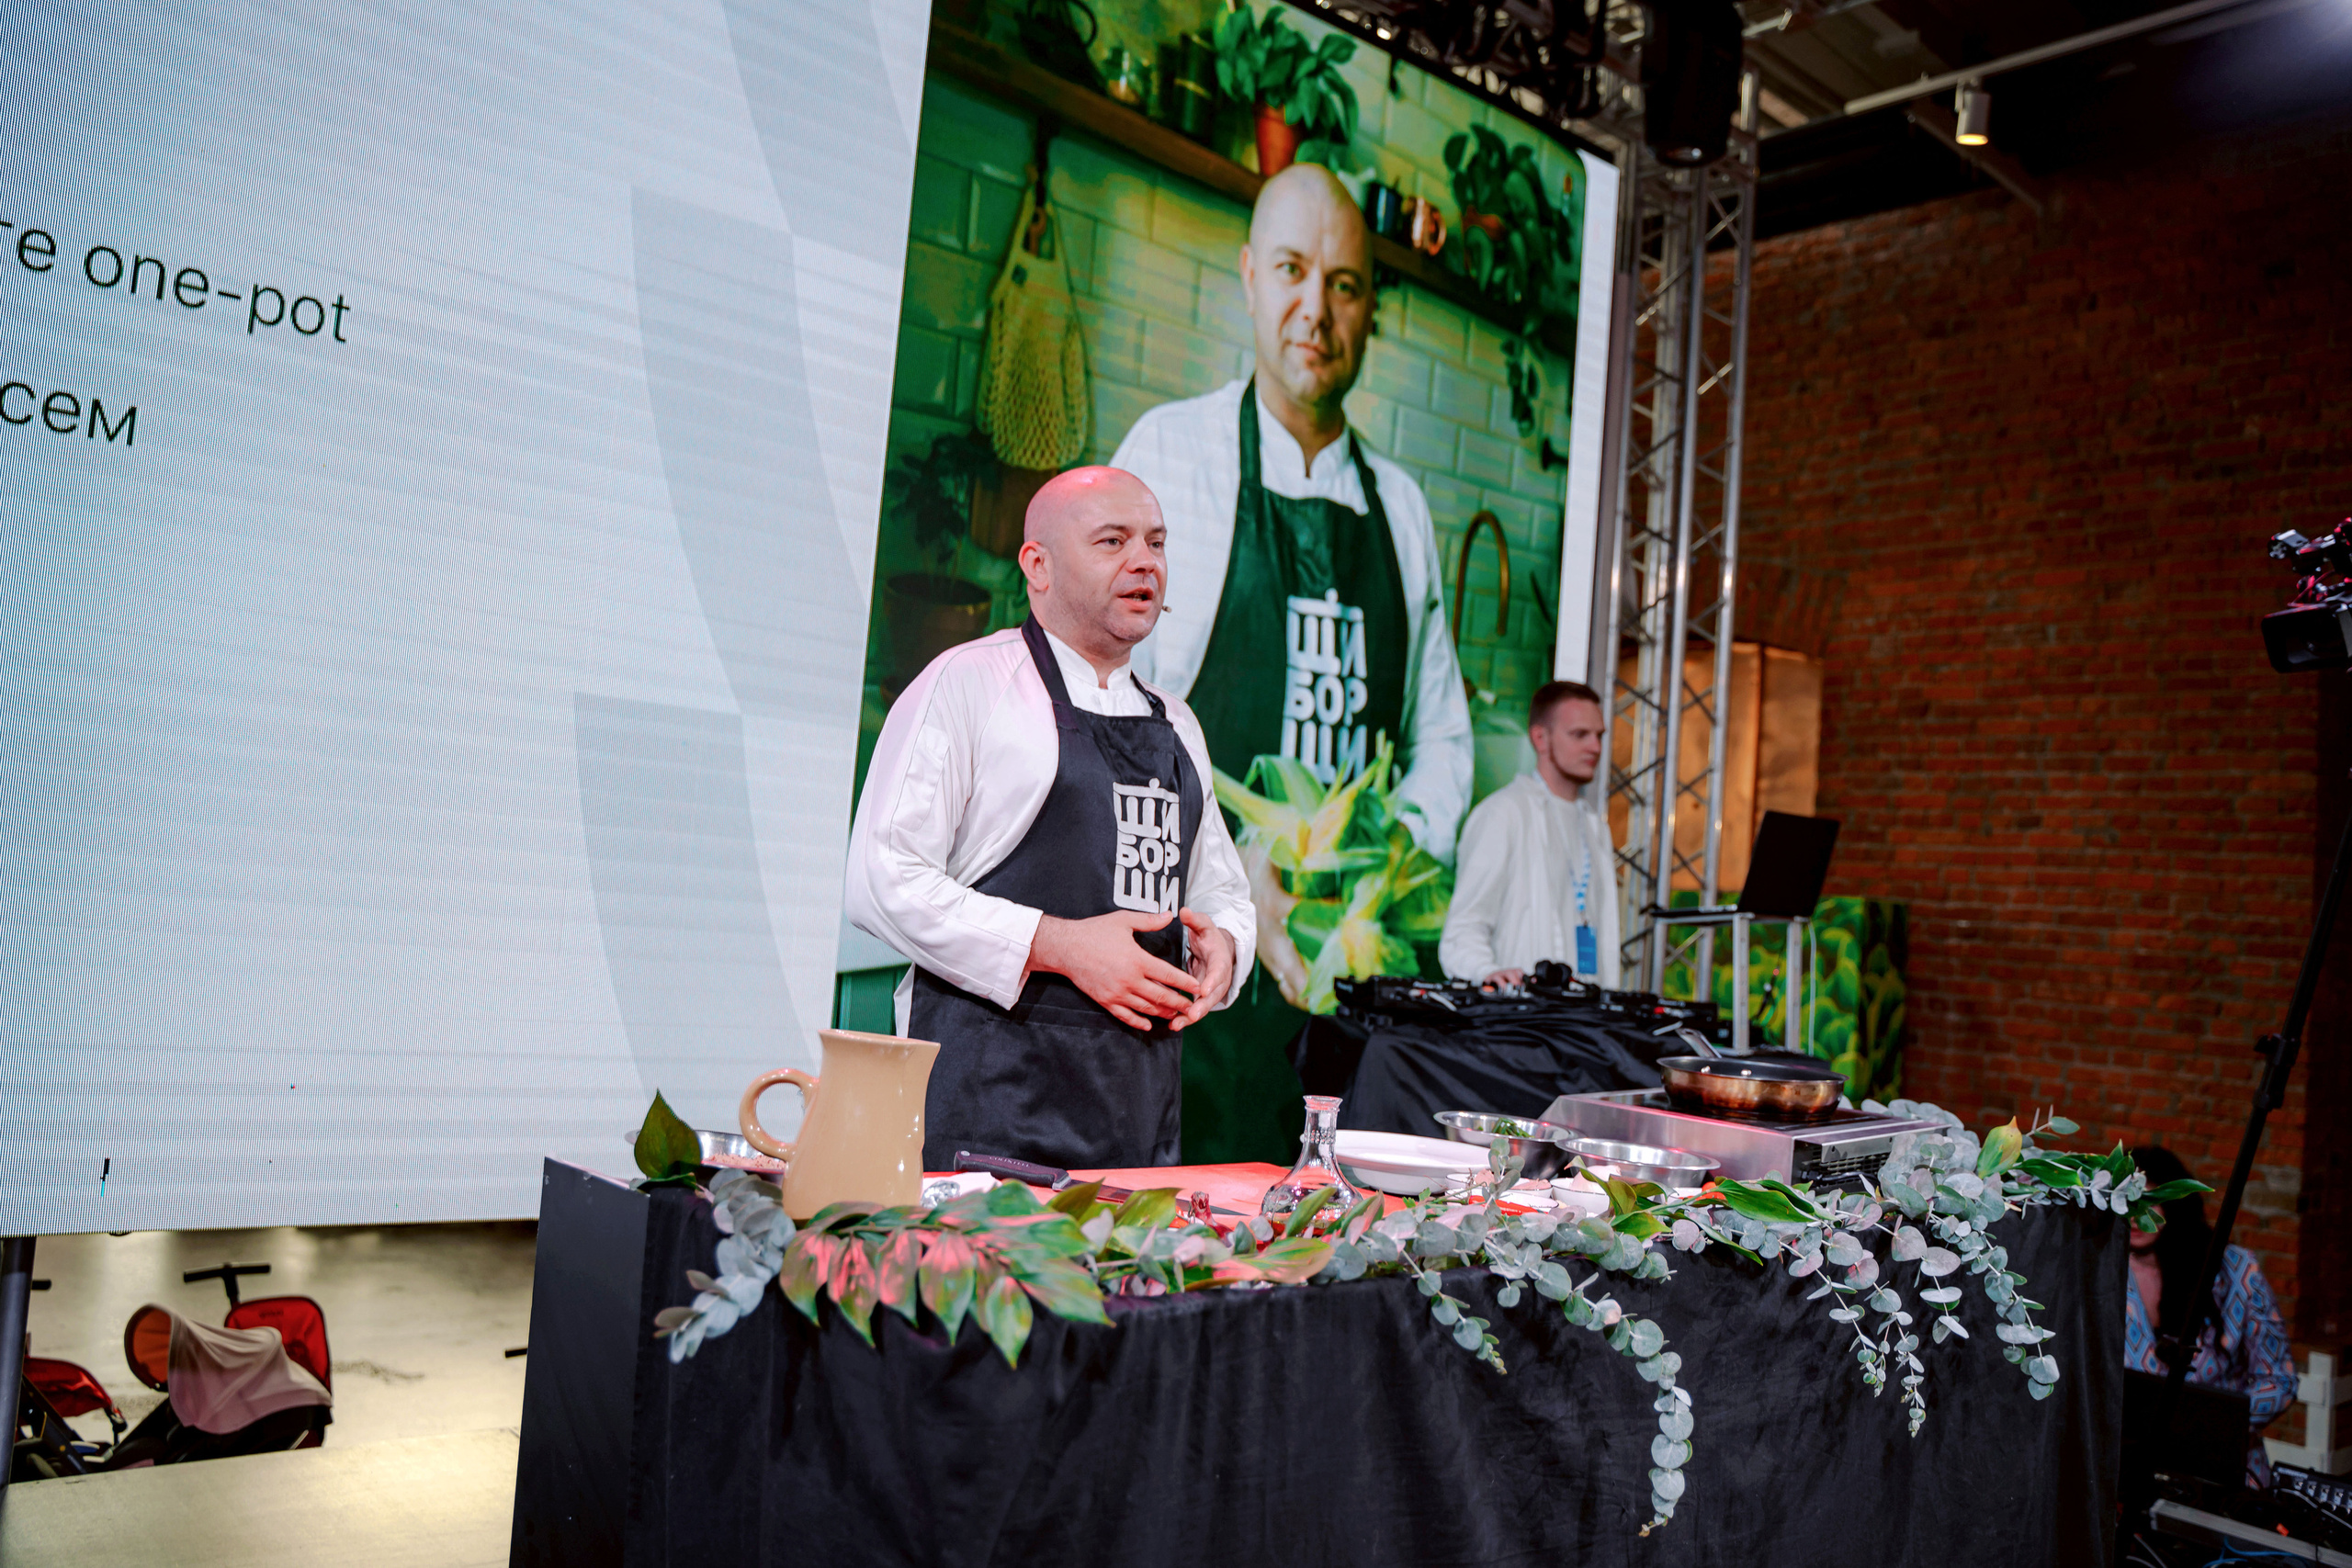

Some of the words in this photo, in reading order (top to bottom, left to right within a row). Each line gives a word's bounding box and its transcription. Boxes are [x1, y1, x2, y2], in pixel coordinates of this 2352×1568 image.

[84, 244, 351, 343] one-pot
[0, 380, 138, 446] сем
[1286, 609, 1368, 680] ЩИ
[1283, 666, 1369, 727] БОР
[1113, 788, 1181, 844] ЩИ
[1115, 829, 1181, 876] БОР
[1113, 863, 1180, 919] ЩИ
